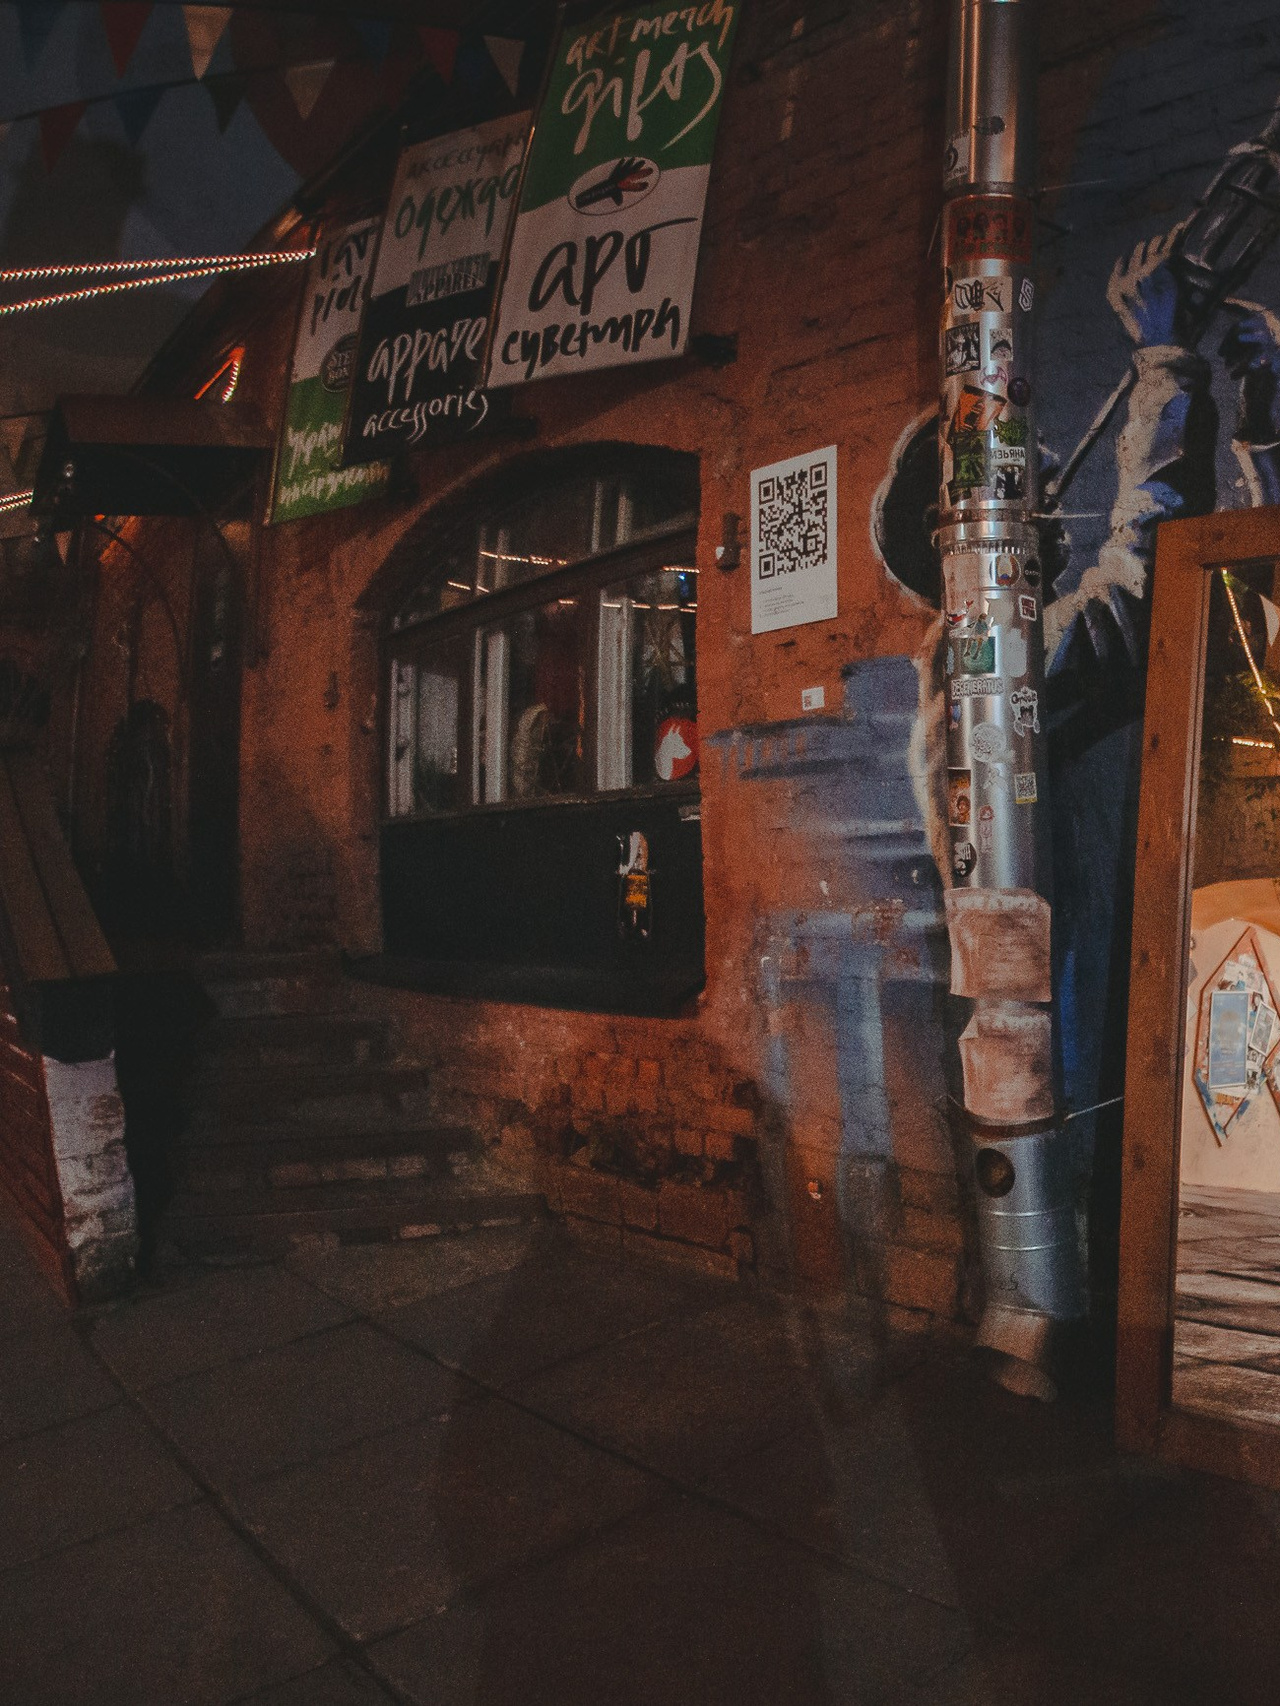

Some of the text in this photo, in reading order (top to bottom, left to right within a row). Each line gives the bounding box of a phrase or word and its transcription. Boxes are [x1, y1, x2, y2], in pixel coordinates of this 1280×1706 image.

[566, 0, 734, 76] art merch
[561, 42, 722, 156] gifts
[528, 217, 698, 316] арт
[366, 317, 487, 404] appare
